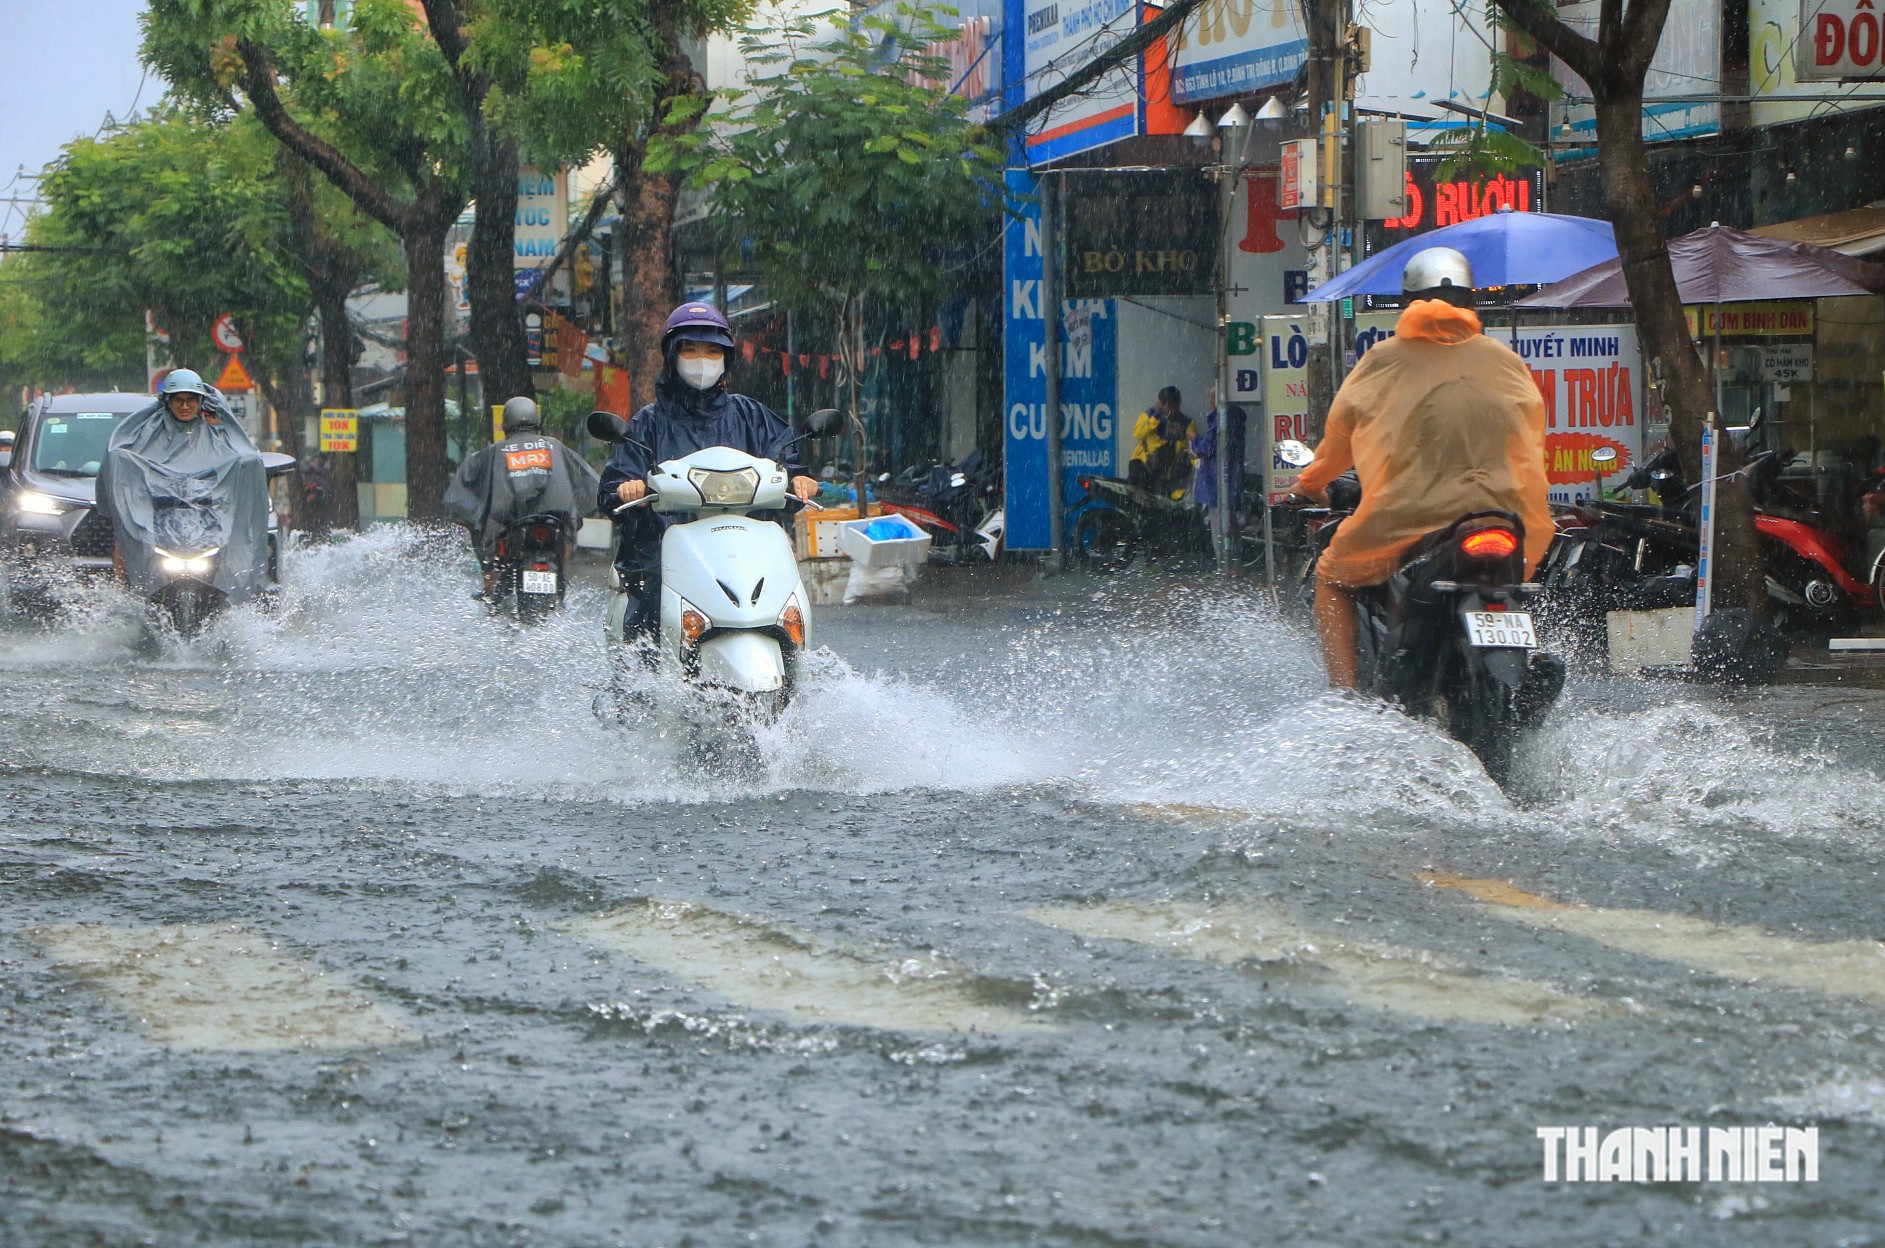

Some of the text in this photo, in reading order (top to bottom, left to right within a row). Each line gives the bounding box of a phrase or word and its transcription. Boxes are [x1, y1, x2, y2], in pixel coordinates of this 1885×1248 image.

[1814, 0, 1885, 67] ĐÔ
[1210, 69, 1217, 90] LỘ
[1083, 243, 1199, 273] BÒ KHO
[1708, 309, 1738, 330] CƠM
[1743, 308, 1776, 330] BÌNH
[1780, 308, 1808, 329] DÂN
[1510, 332, 1619, 358] TUYẾT MINH
[1774, 369, 1800, 378] 45K
[1564, 361, 1634, 428] TRƯA
[329, 419, 349, 430] 10K
[328, 441, 350, 450] 10K
[509, 453, 550, 467] MAX
[1553, 445, 1574, 472] ĂN
[527, 572, 551, 583] 50-AE
[1474, 613, 1523, 628] 59-NA
[1475, 629, 1533, 646] 130.02
